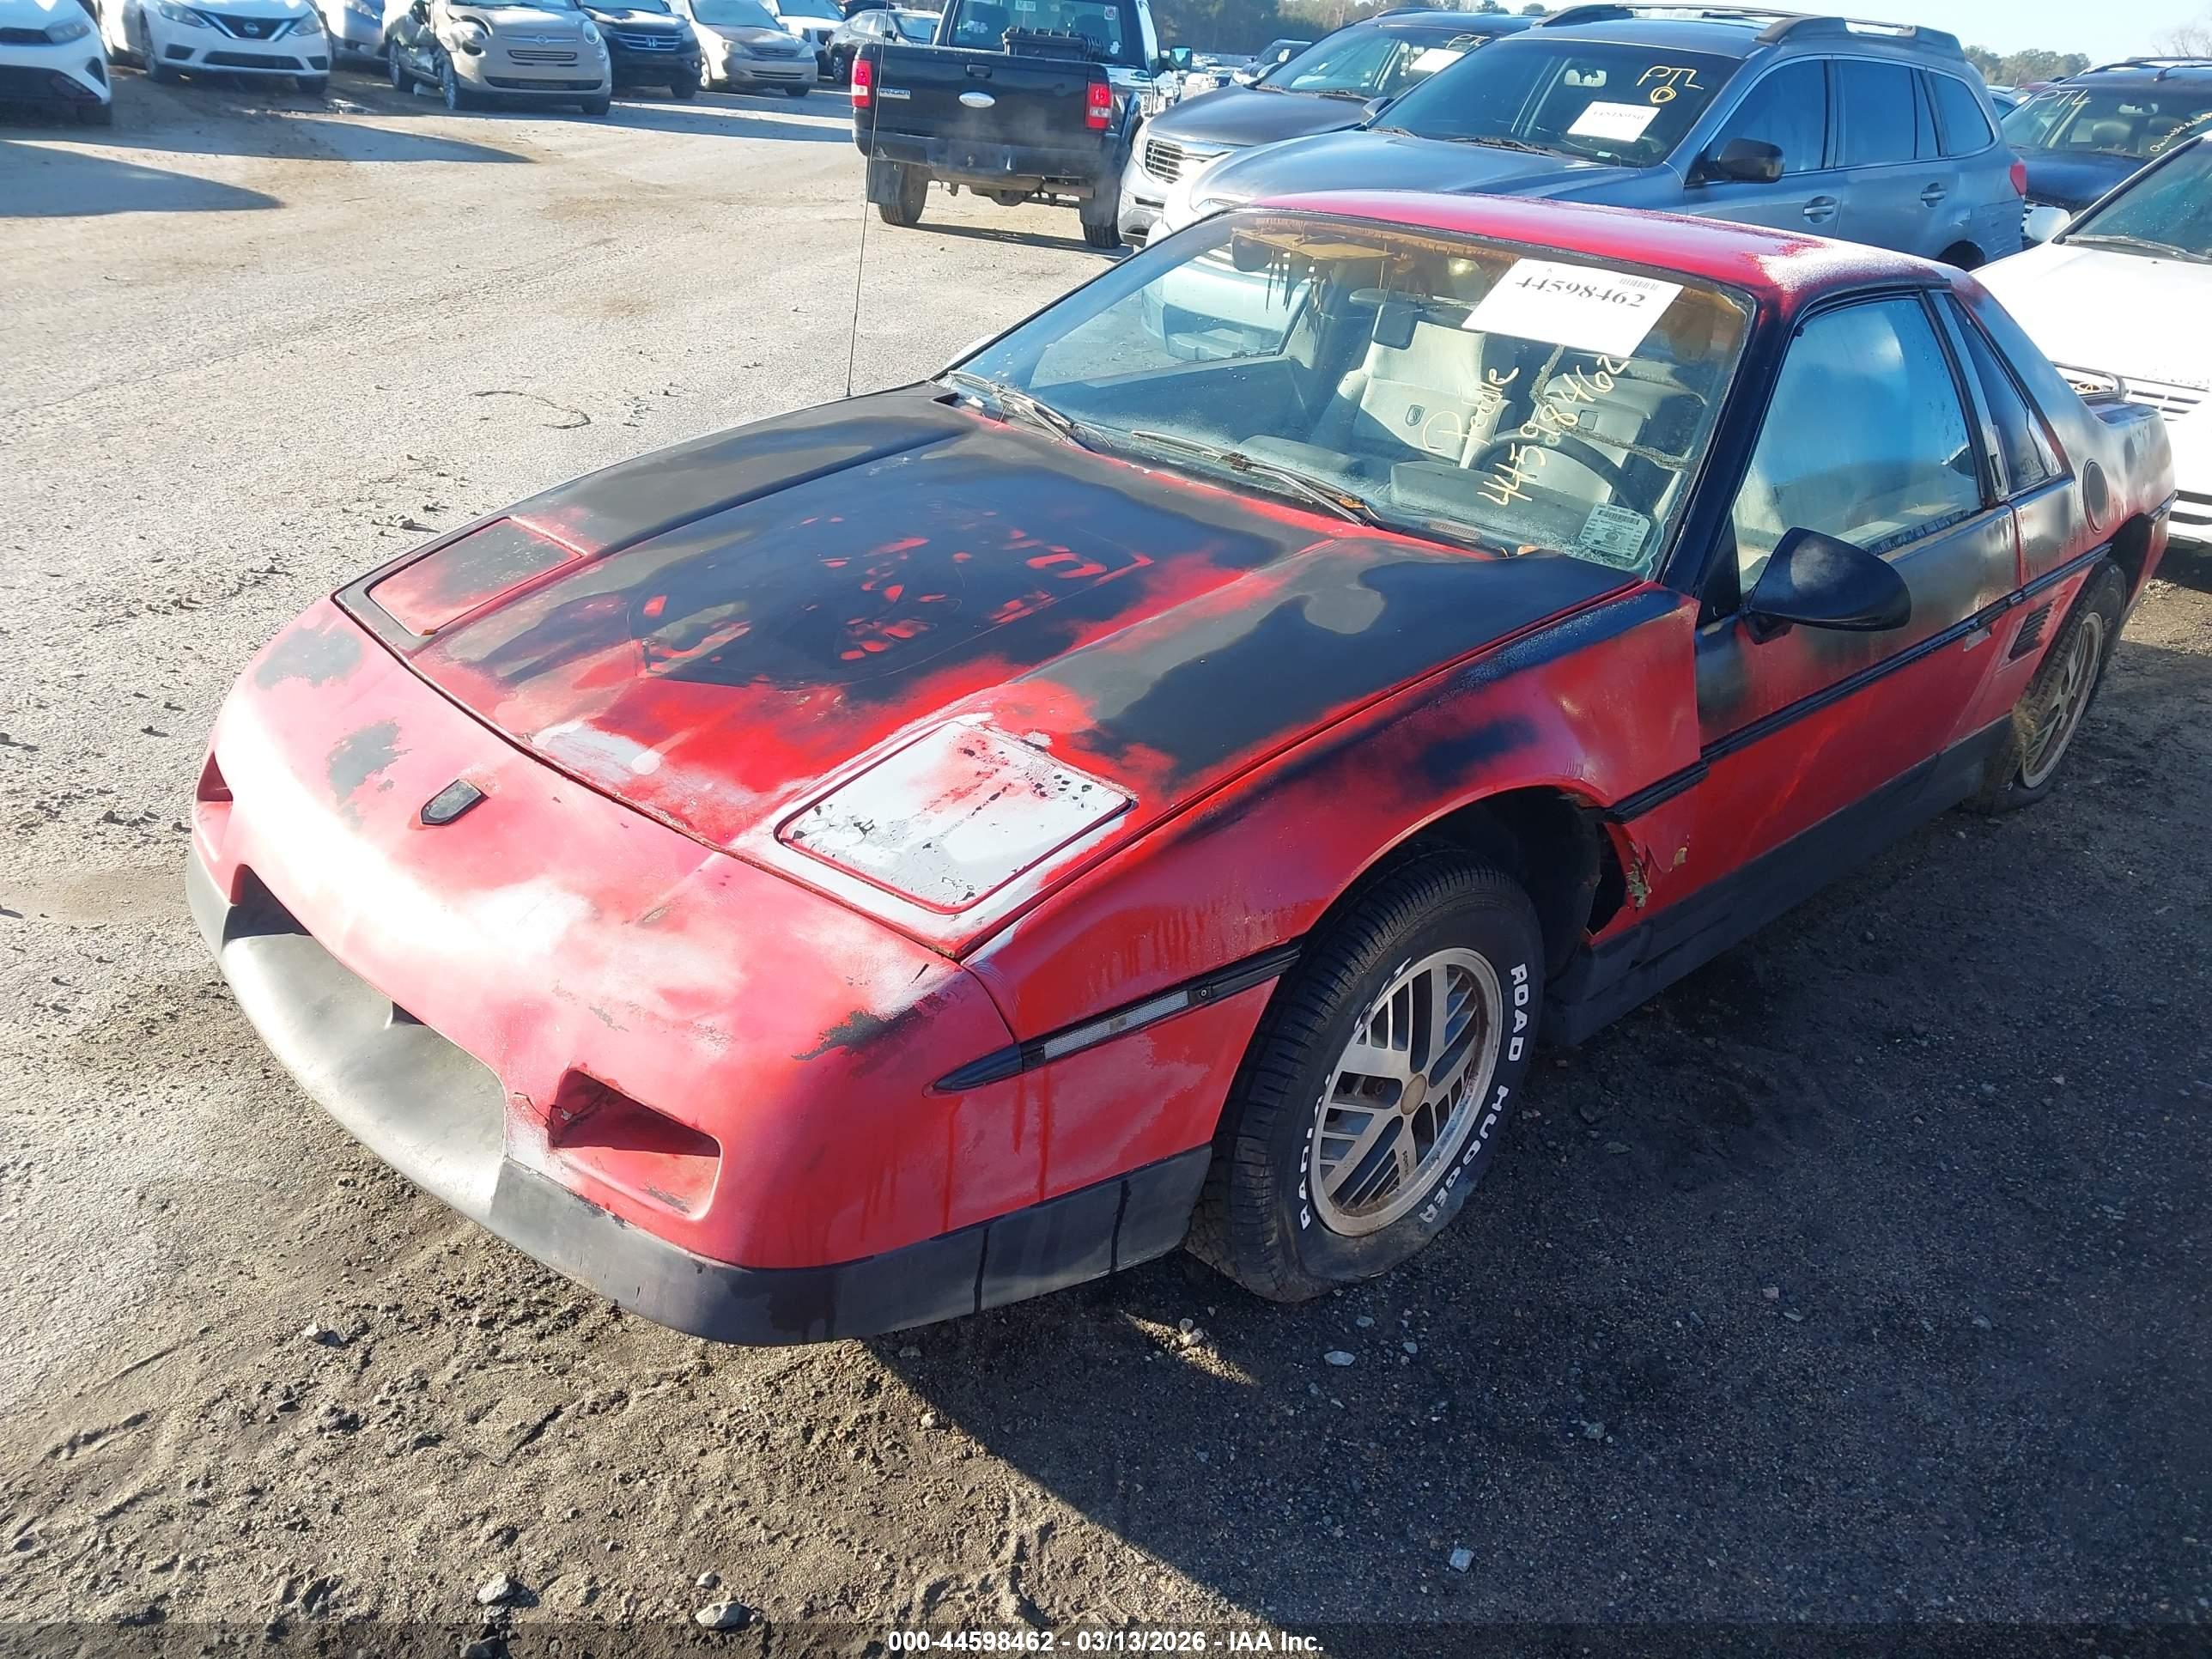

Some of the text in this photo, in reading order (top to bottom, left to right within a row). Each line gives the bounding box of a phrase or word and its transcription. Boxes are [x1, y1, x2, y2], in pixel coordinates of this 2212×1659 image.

[2023, 89, 2092, 112] PTL
[1515, 276, 1646, 307] 44598462
[1476, 355, 1631, 506] 44598462
[1419, 963, 1529, 1224] ROAD HUGGER
